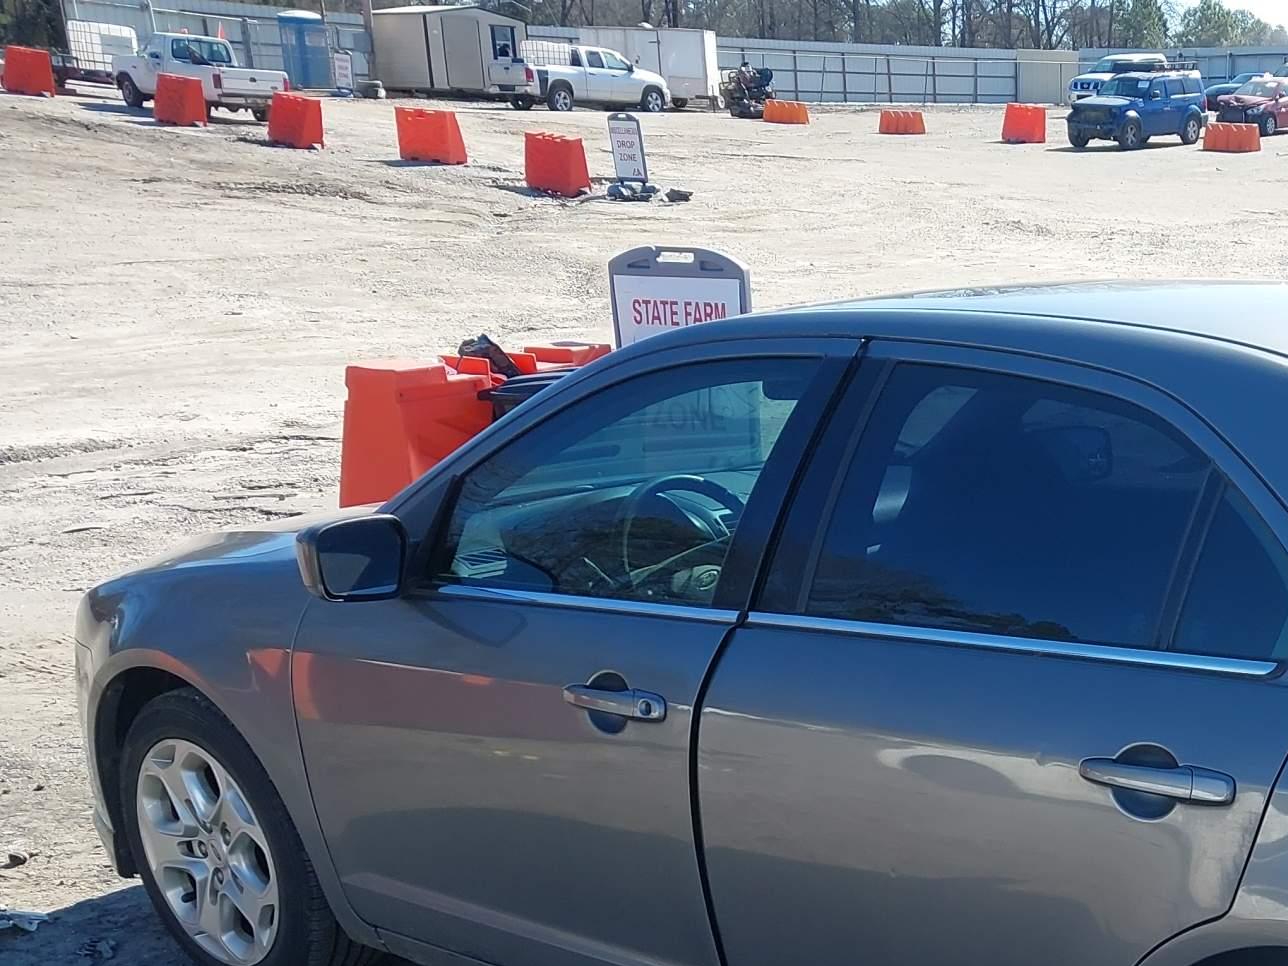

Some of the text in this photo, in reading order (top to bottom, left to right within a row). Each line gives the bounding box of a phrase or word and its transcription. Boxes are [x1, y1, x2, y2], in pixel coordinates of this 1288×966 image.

[616, 140, 636, 149] DROP
[619, 153, 638, 162] ZONE
[632, 298, 727, 327] STATE FARM
